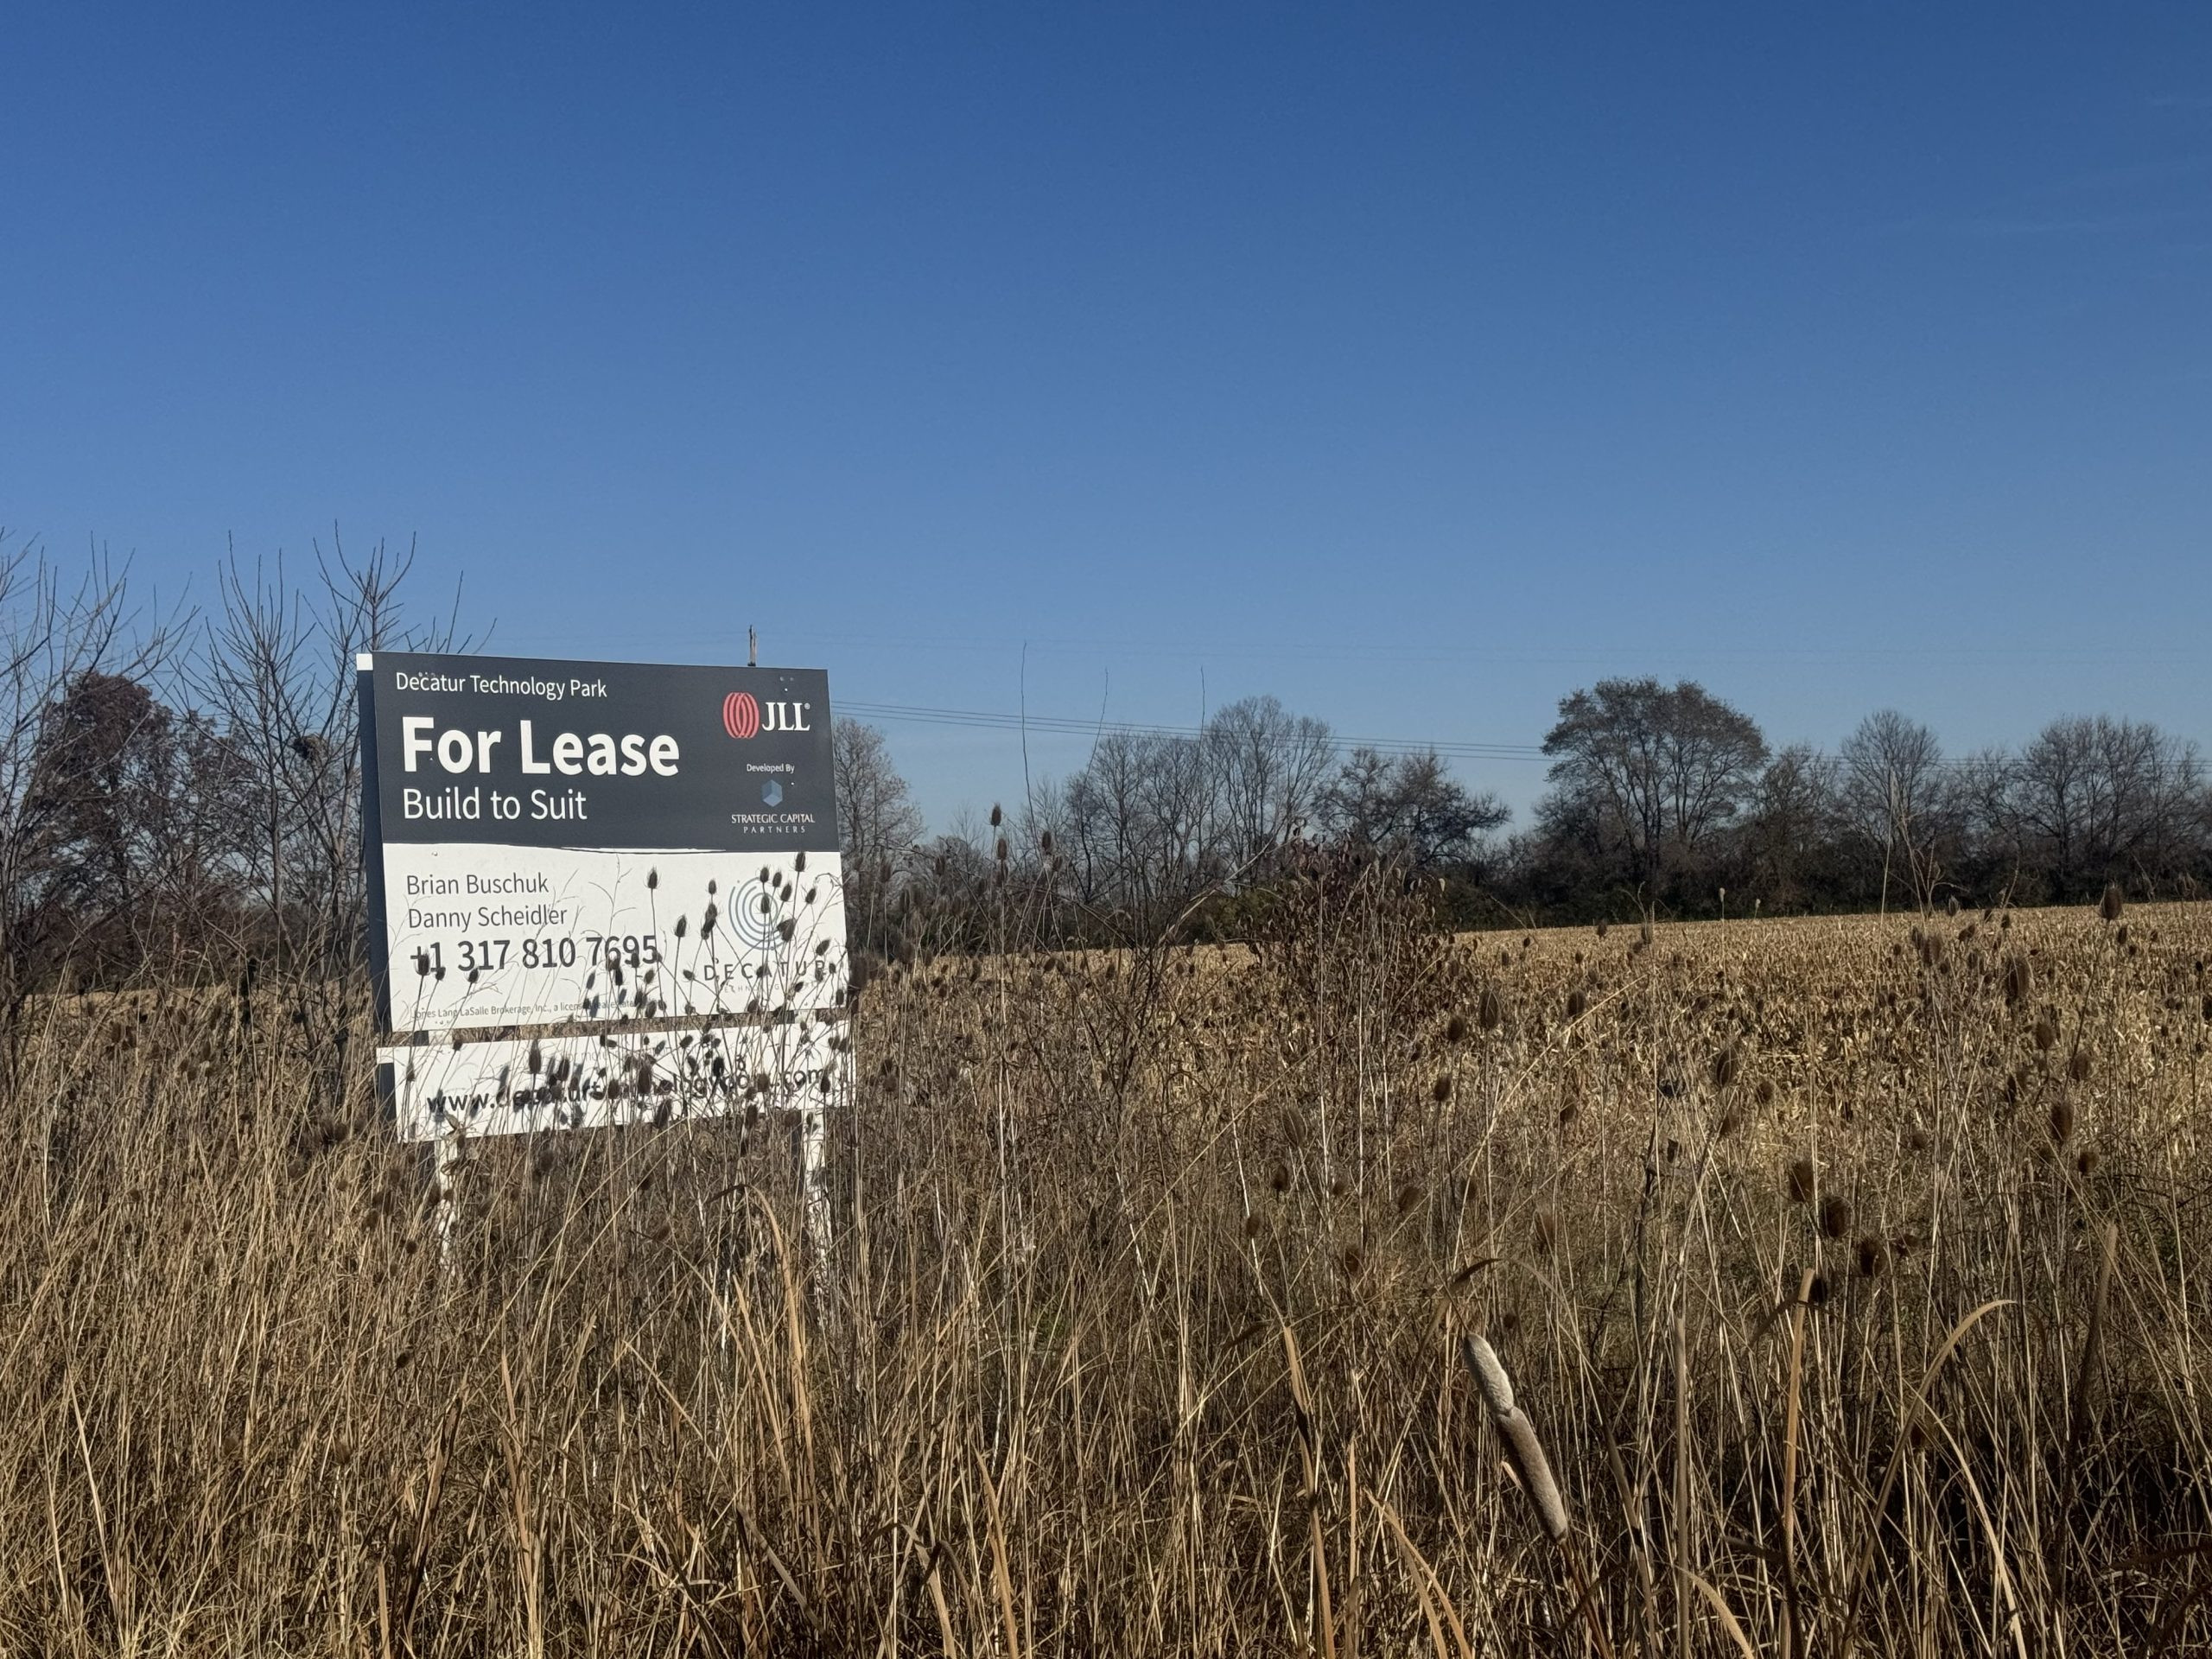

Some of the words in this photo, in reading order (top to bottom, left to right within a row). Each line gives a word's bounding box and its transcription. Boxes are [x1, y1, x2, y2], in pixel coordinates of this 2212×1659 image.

[396, 671, 466, 692] Decatur
[470, 675, 565, 701] Technology
[570, 678, 607, 697] Park
[402, 716, 502, 774] For
[520, 719, 680, 777] Lease
[747, 763, 784, 773] Developed
[785, 764, 795, 774] By
[403, 786, 480, 820] Build
[490, 790, 520, 820] to
[531, 788, 588, 820] Suit
[731, 814, 778, 824] STRATEGIC
[779, 813, 816, 823] CAPITAL
[743, 825, 805, 834] PARTNERS
[406, 874, 459, 895] Brian
[467, 872, 550, 894] Buschuk
[409, 908, 472, 933] Danny
[478, 904, 568, 927] Scheidler
[457, 939, 511, 972] 317
[522, 938, 576, 969] 810
[586, 935, 658, 968] 7695
[438, 1008, 458, 1020] Lang
[460, 1006, 489, 1017] LaSalle
[491, 1004, 533, 1017] Brokerage,
[561, 1001, 591, 1012] licens
